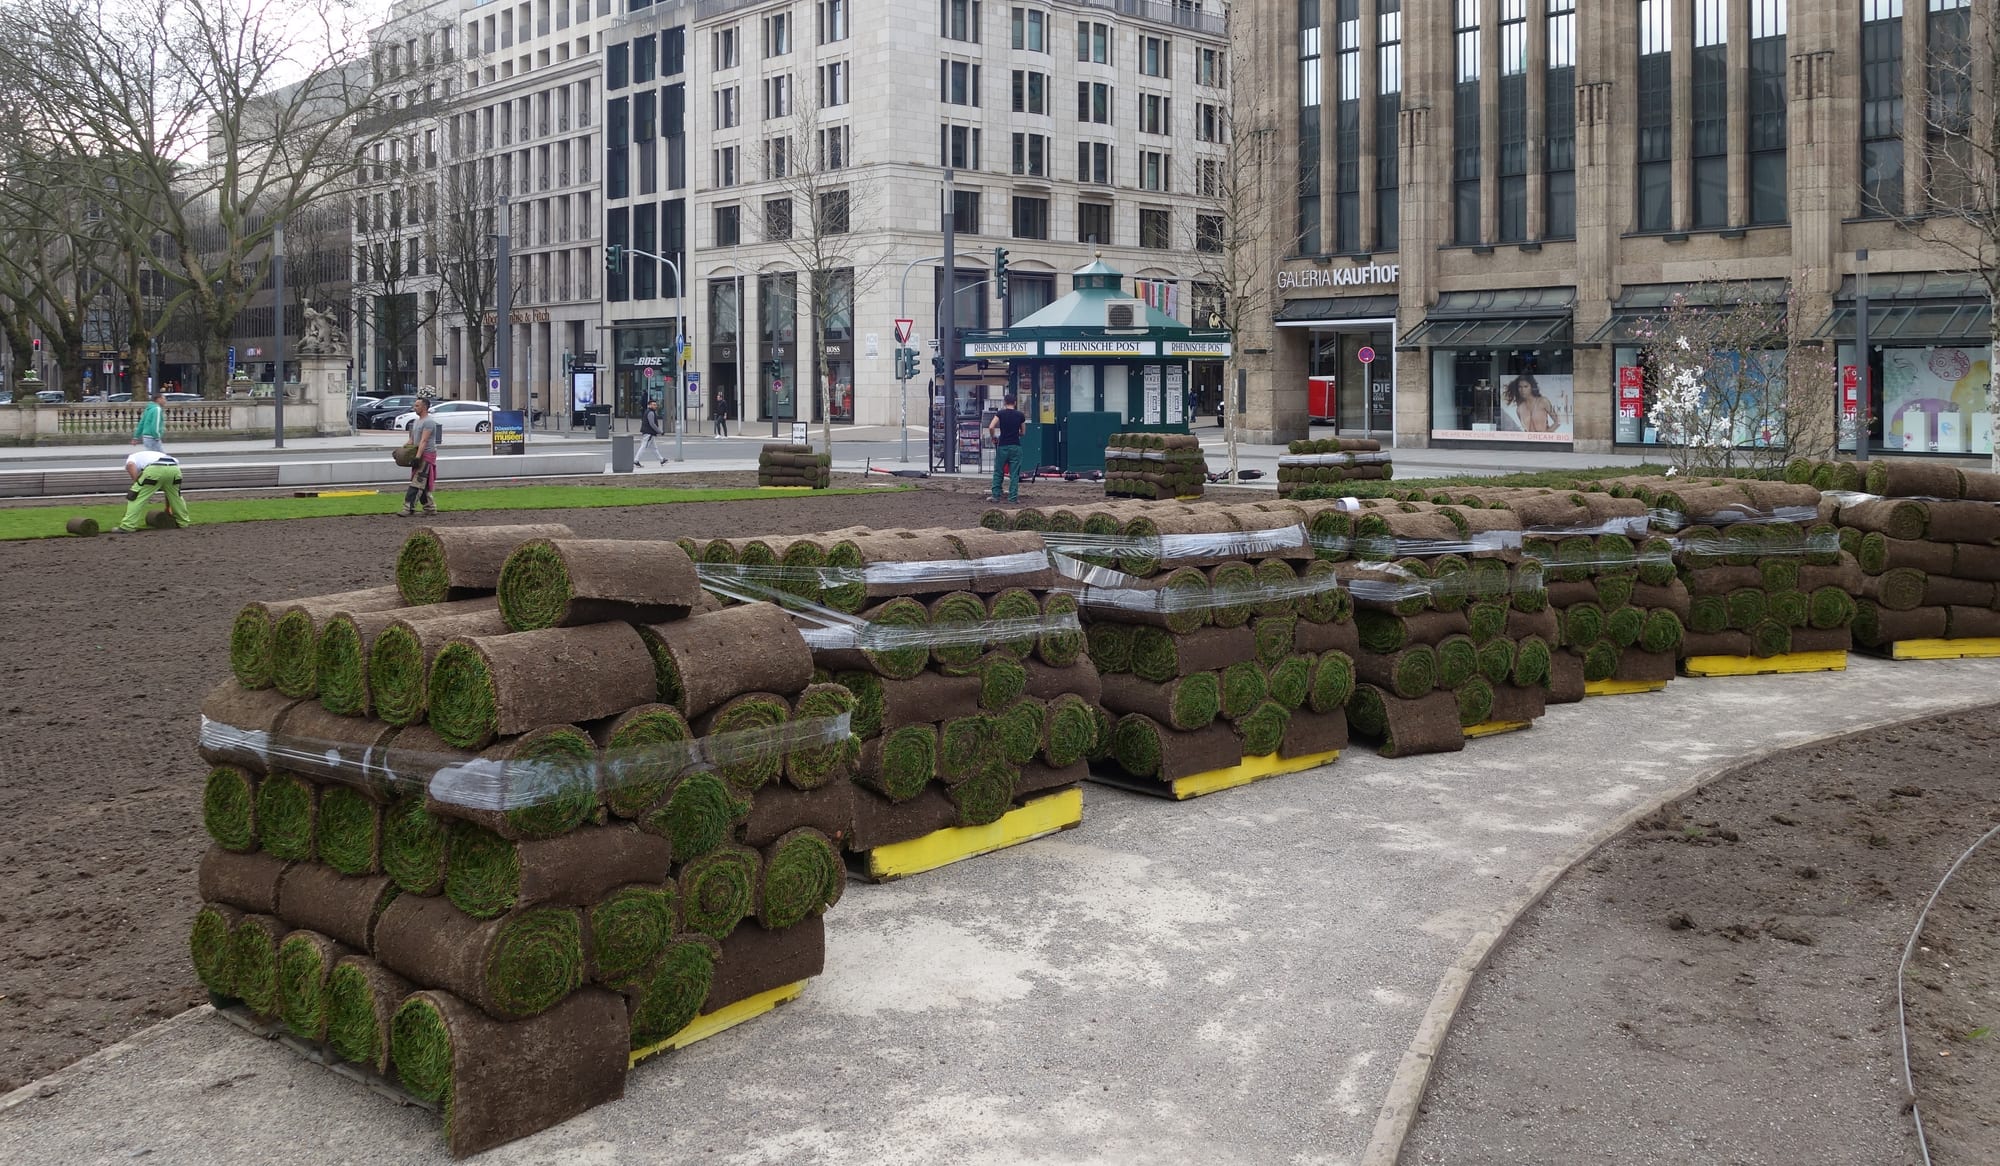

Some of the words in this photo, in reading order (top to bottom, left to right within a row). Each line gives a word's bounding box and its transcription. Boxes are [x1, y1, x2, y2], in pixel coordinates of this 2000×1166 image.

[1277, 269, 1332, 289] GALERIA
[826, 345, 840, 353] BOSS
[974, 343, 1010, 353] RHEINISCHE
[1010, 342, 1028, 352] POST
[1060, 341, 1114, 351] RHEINISCHE
[1116, 341, 1140, 351] POST
[1171, 342, 1206, 352] RHEINISCHE
[1207, 343, 1224, 352] POST
[634, 356, 665, 366] BOSE
[1373, 383, 1391, 393] DIE
[1619, 409, 1636, 418] DIE
